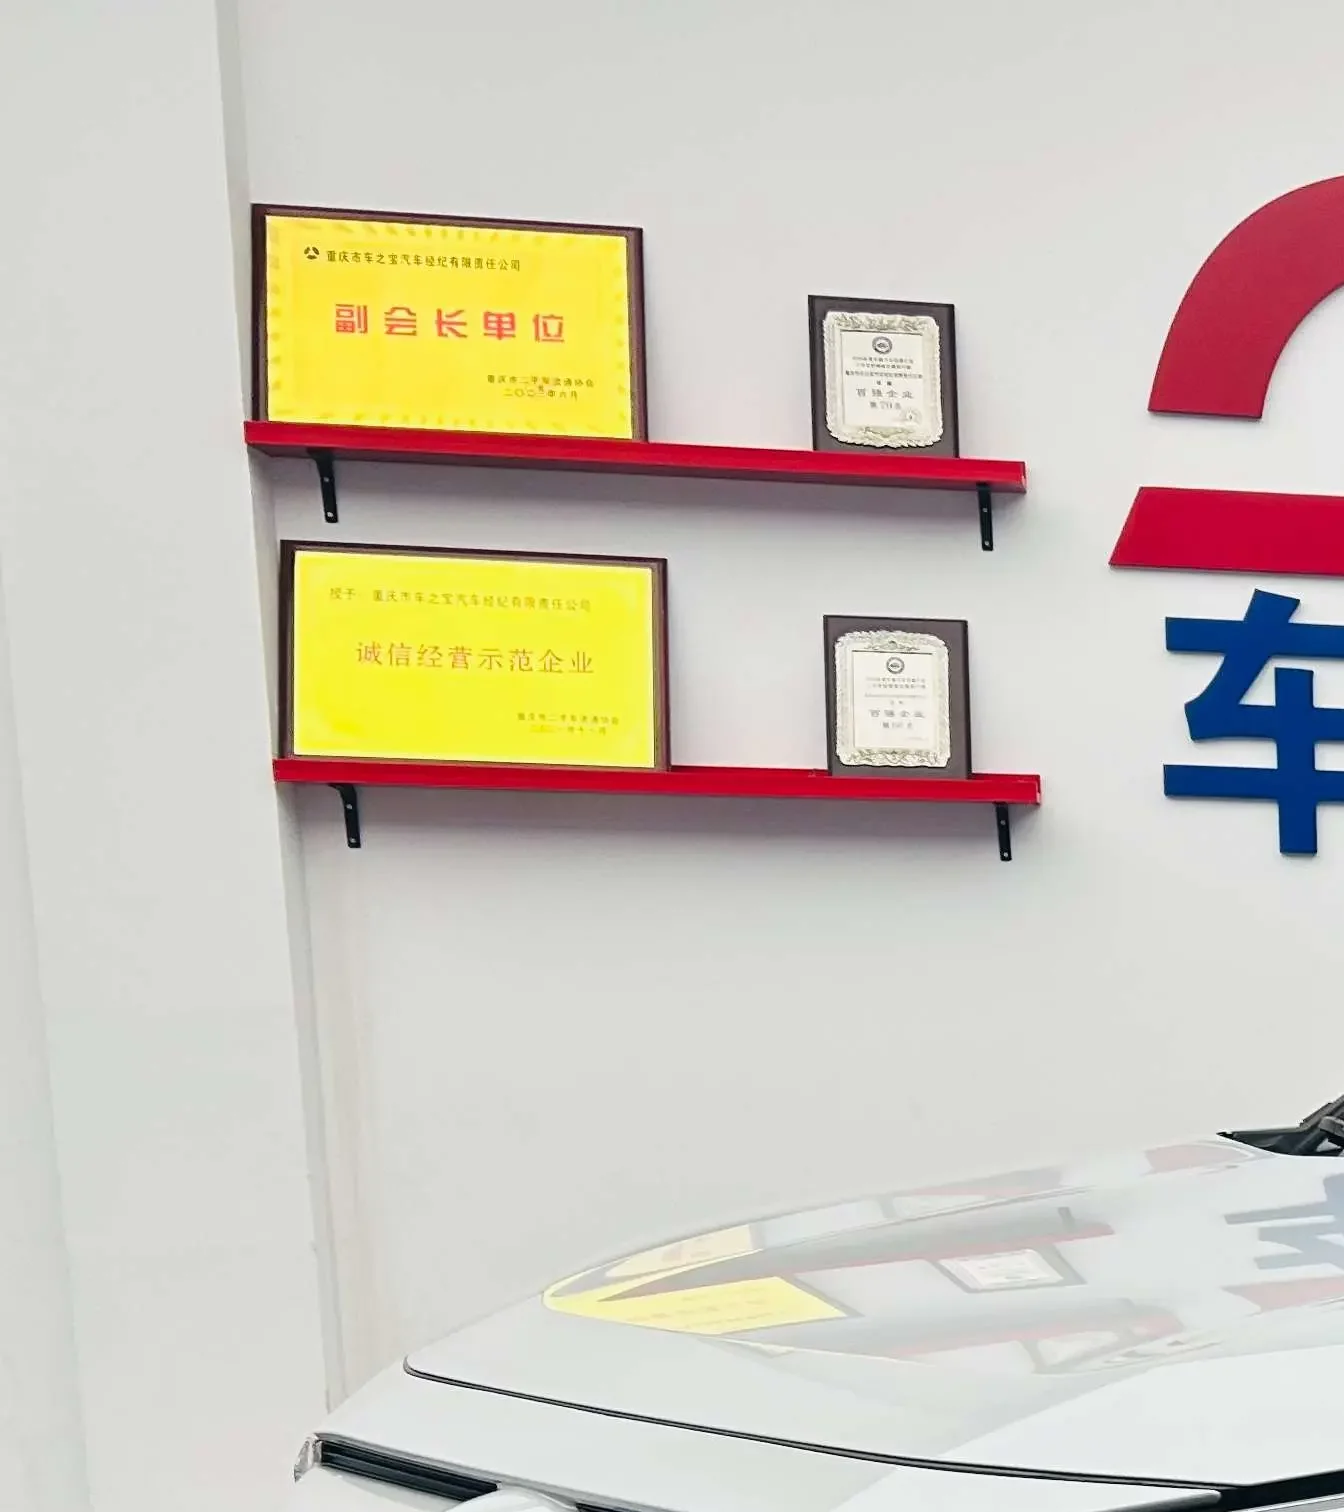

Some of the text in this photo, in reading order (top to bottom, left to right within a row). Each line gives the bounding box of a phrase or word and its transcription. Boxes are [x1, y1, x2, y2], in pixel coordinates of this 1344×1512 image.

[335, 303, 565, 343] 副会长单位
[356, 641, 595, 674] 诚信经营示范企业
